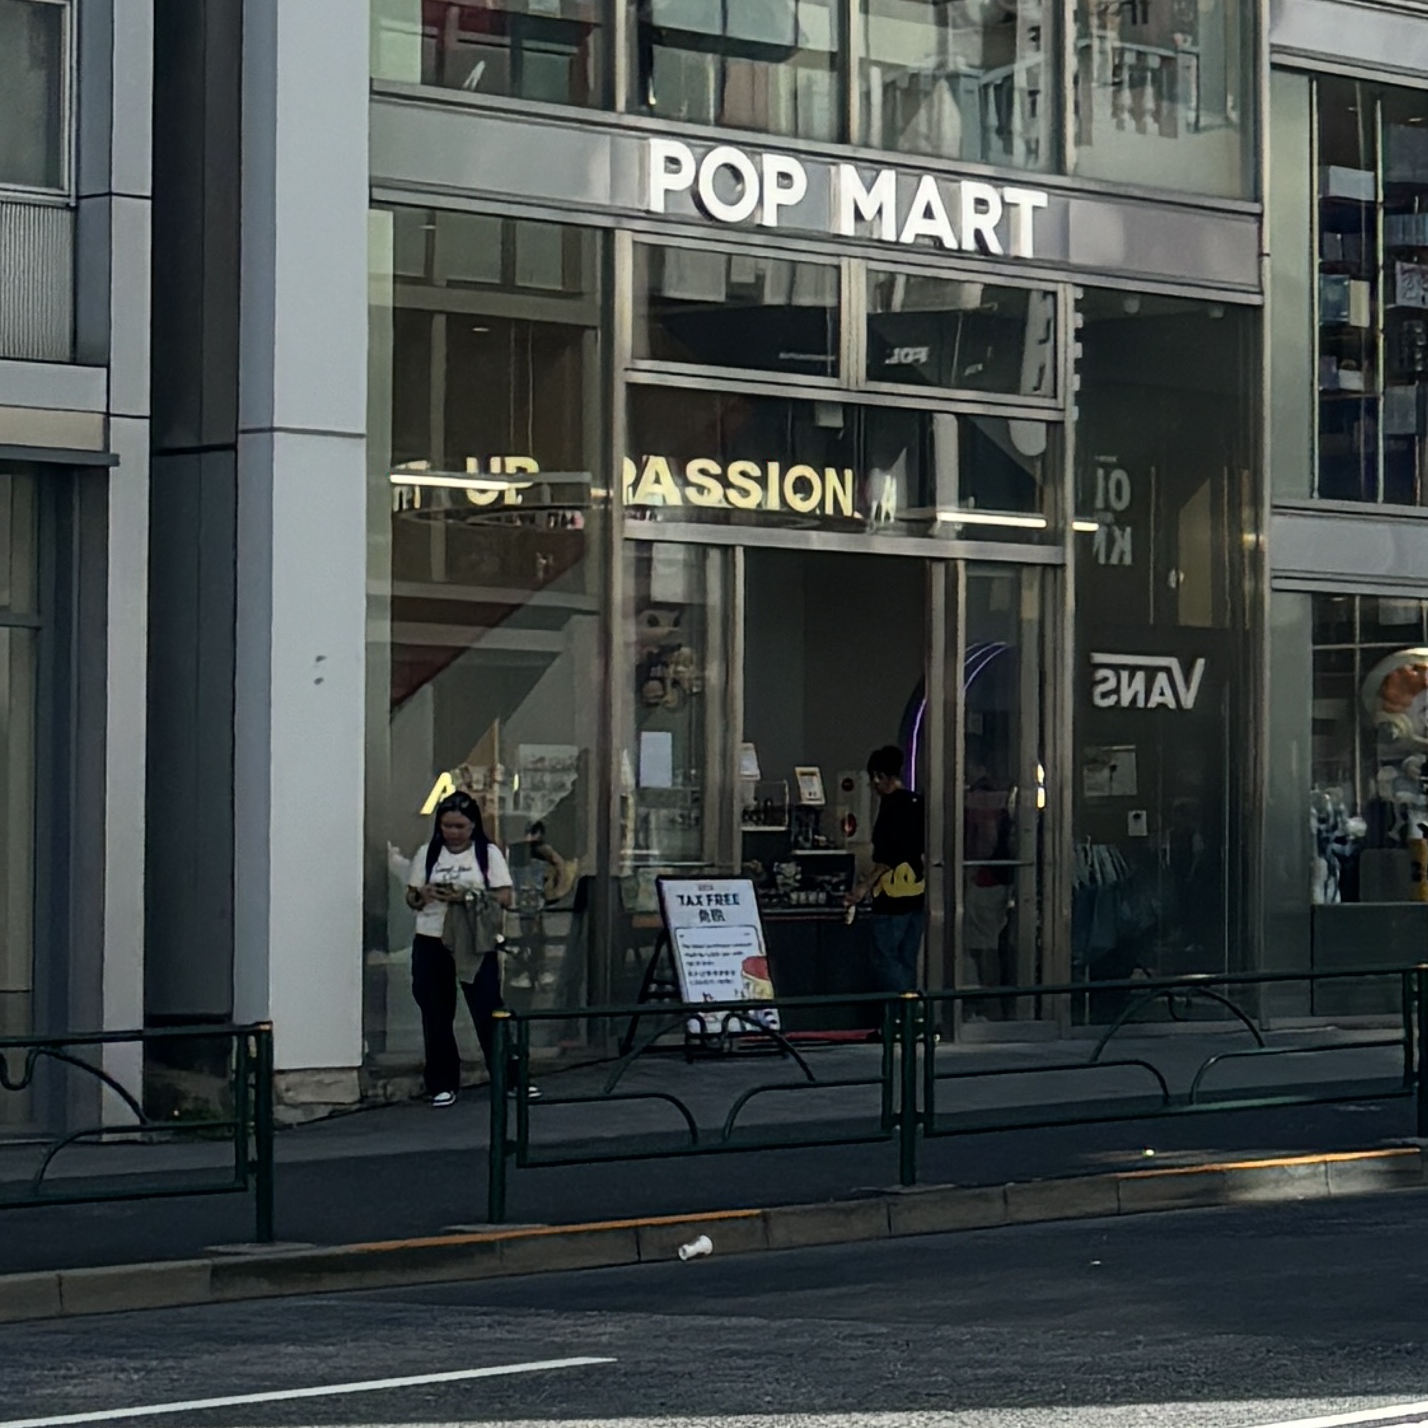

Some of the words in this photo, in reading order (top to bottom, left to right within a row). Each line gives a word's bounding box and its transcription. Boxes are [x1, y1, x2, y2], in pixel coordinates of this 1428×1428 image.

[648, 138, 808, 228] POP
[836, 162, 1049, 260] MART
[676, 893, 704, 907] TAX
[706, 892, 740, 907] FREE
